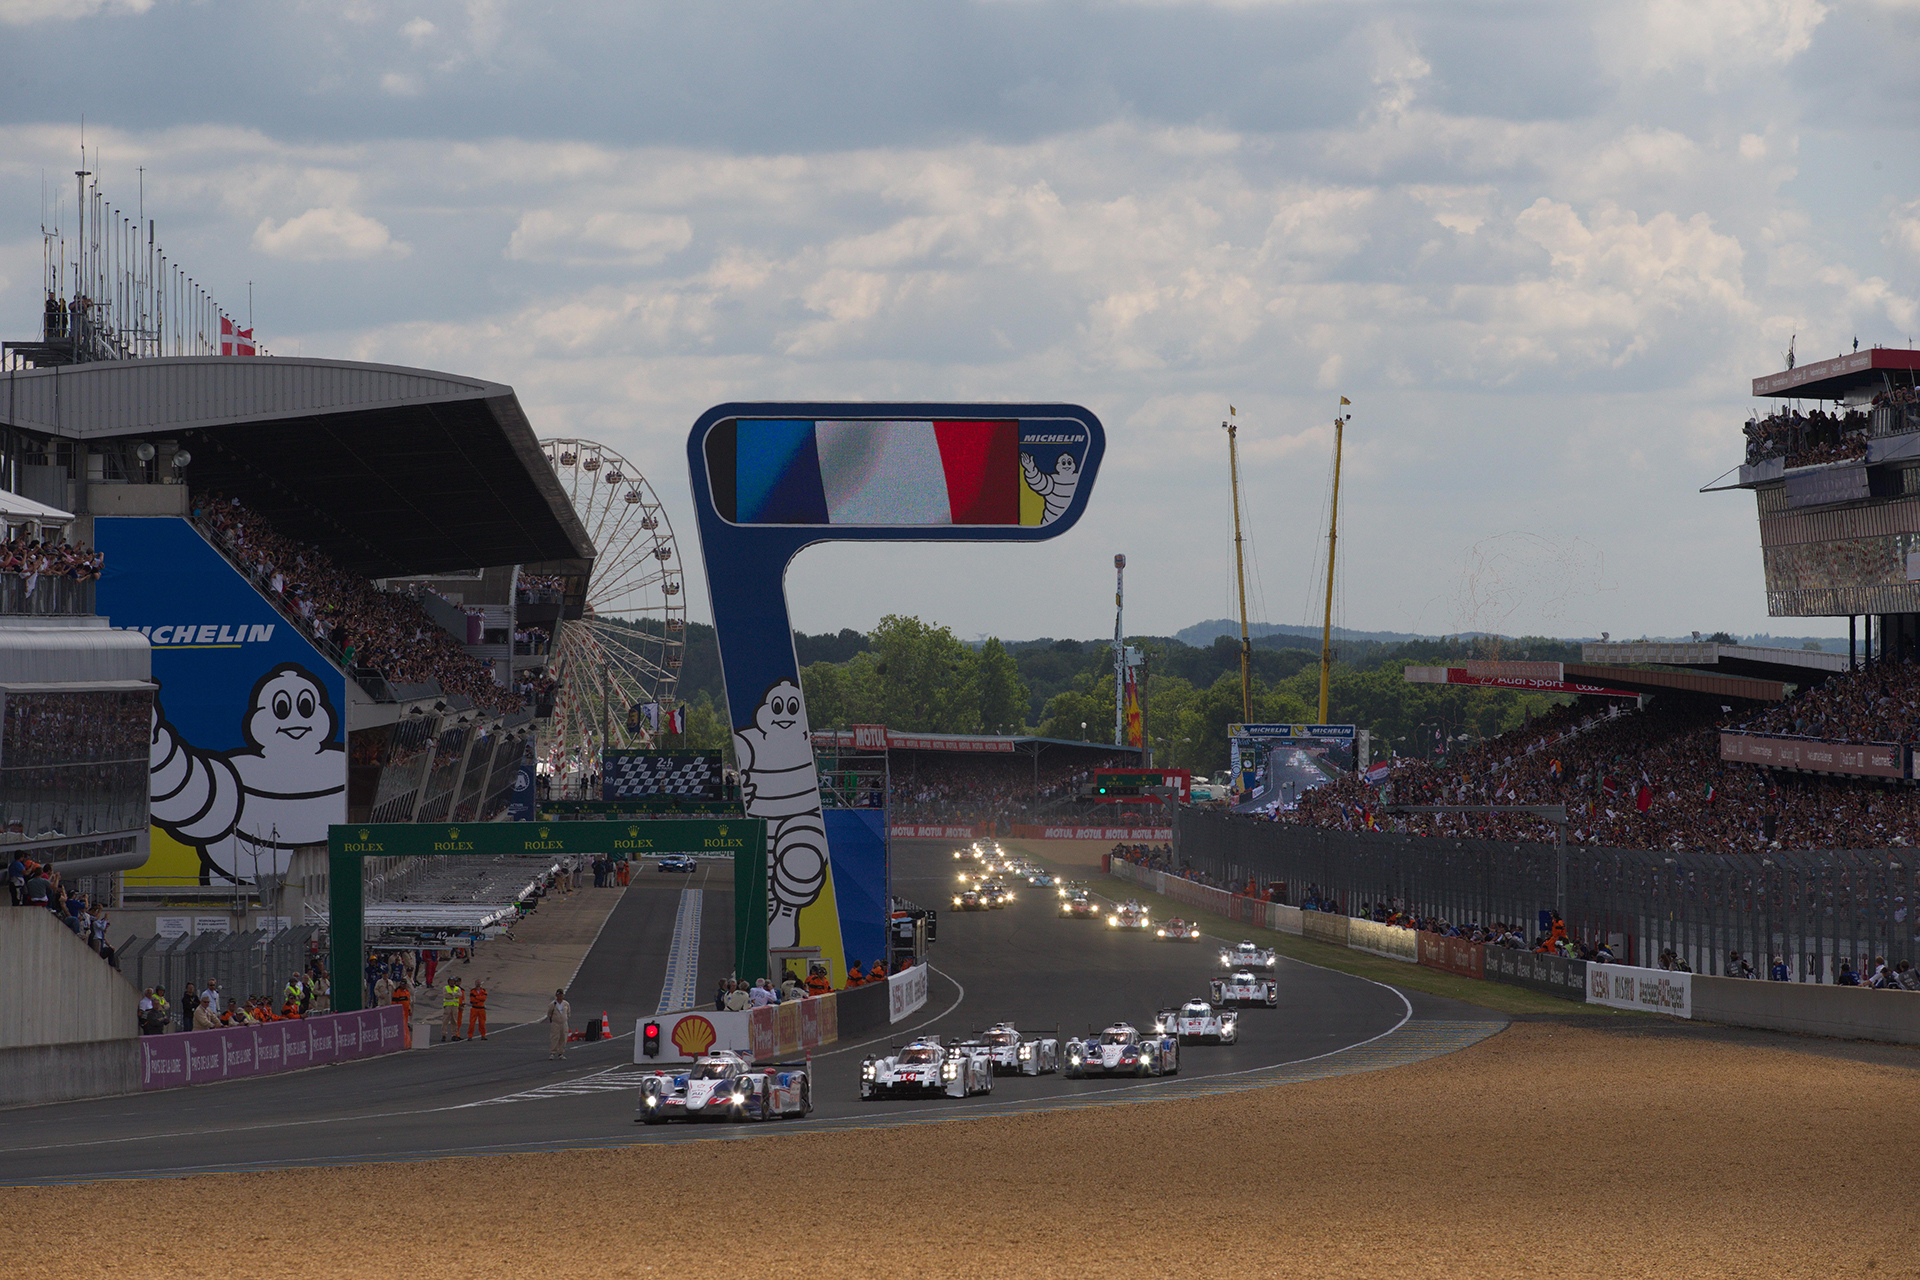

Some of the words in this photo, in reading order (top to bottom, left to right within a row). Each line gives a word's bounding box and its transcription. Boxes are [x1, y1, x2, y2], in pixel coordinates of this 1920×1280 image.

[111, 624, 275, 644] ICHELIN
[856, 728, 886, 747] MOTUL
[1154, 829, 1172, 839] MOTU
[344, 843, 384, 851] ROLEX
[434, 842, 474, 850] ROLEX
[524, 841, 564, 849] ROLEX
[614, 839, 653, 848] ROLEX
[704, 839, 743, 847] ROLEX
[901, 1073, 915, 1081] 14
